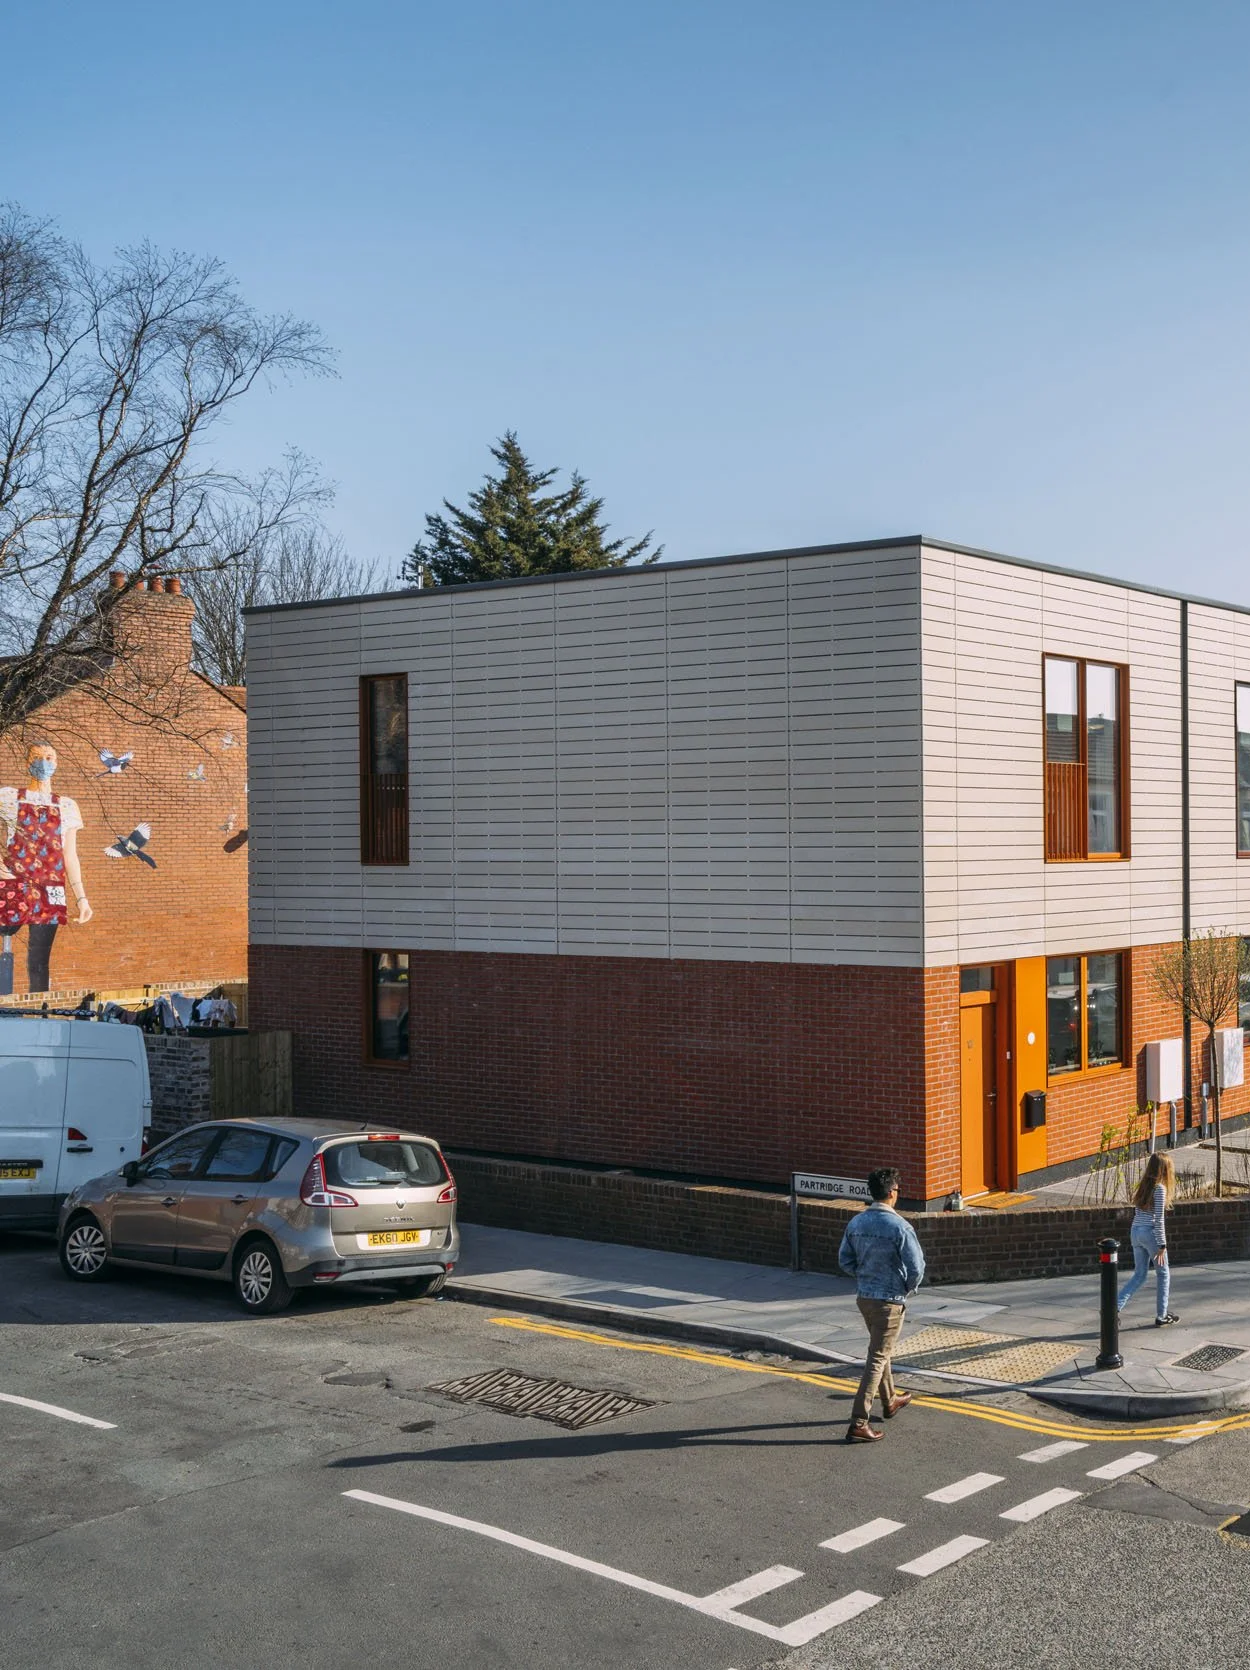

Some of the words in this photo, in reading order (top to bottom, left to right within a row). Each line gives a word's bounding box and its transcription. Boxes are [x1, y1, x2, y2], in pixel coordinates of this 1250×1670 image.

[800, 1180, 844, 1193] PARTRIDGE
[849, 1185, 871, 1197] ROAD
[372, 1232, 398, 1245] EK60
[400, 1231, 417, 1243] JGV
